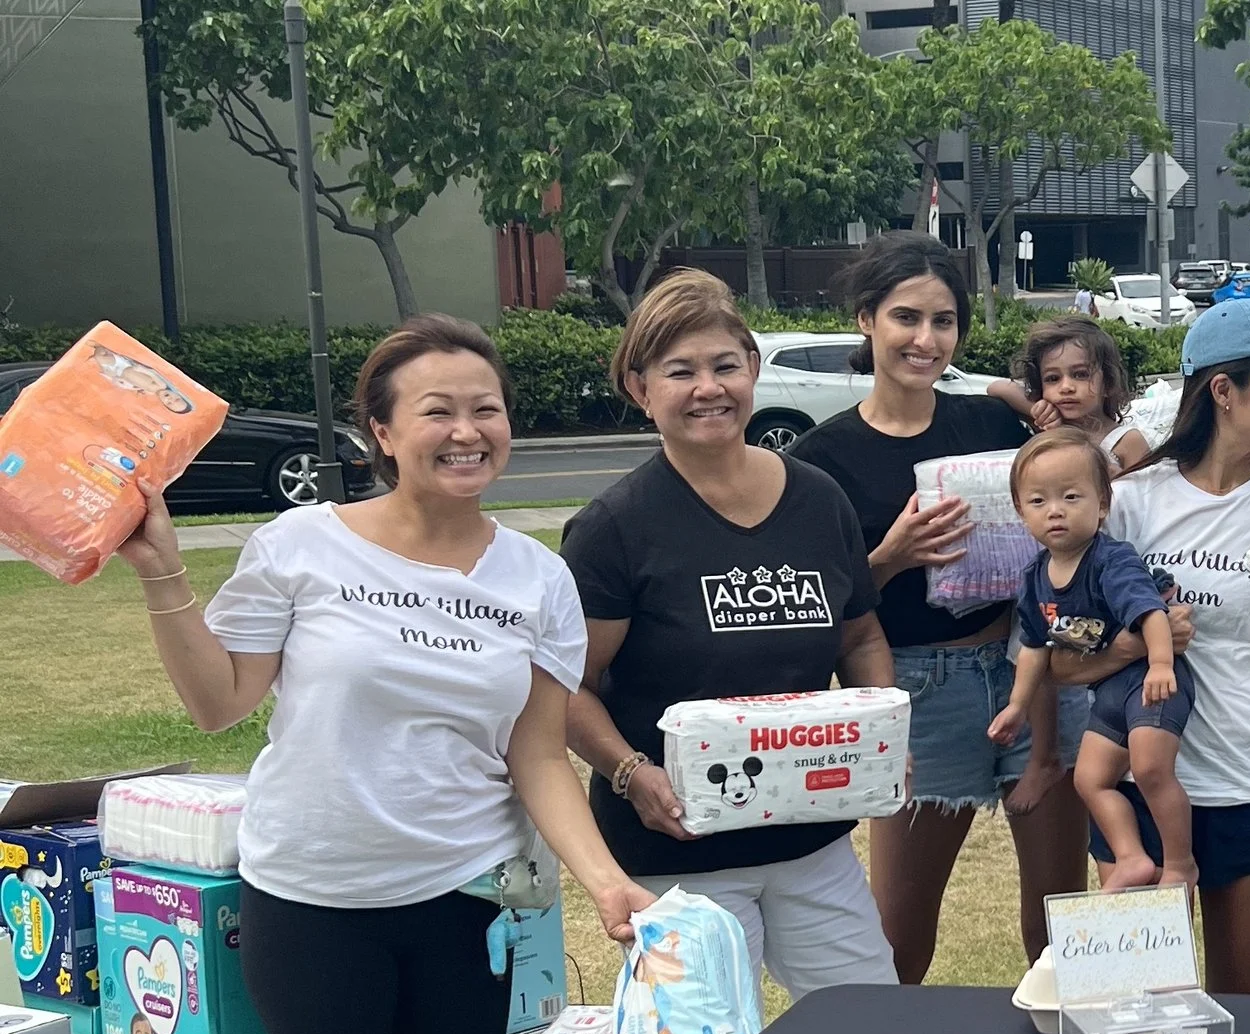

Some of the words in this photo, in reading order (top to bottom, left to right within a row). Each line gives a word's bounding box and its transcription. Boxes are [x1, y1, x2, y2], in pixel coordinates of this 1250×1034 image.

[62, 487, 75, 500] to
[78, 483, 112, 509] cuddle
[1143, 549, 1187, 566] ard
[712, 579, 822, 609] ALOHA
[715, 610, 776, 625] diaper
[784, 606, 827, 620] bank
[751, 721, 861, 752] HUGGIES
[794, 755, 826, 768] snug
[828, 753, 837, 765] &
[840, 752, 861, 764] dry
[893, 782, 899, 799] 1
[80, 867, 113, 883] Pampe
[116, 877, 137, 894] SAVE
[20, 889, 33, 960] Pampers
[1062, 931, 1111, 959] Enter
[1117, 933, 1136, 952] to
[1140, 926, 1185, 951] Win
[137, 966, 176, 998] Pampers
[145, 999, 172, 1015] cruisers
